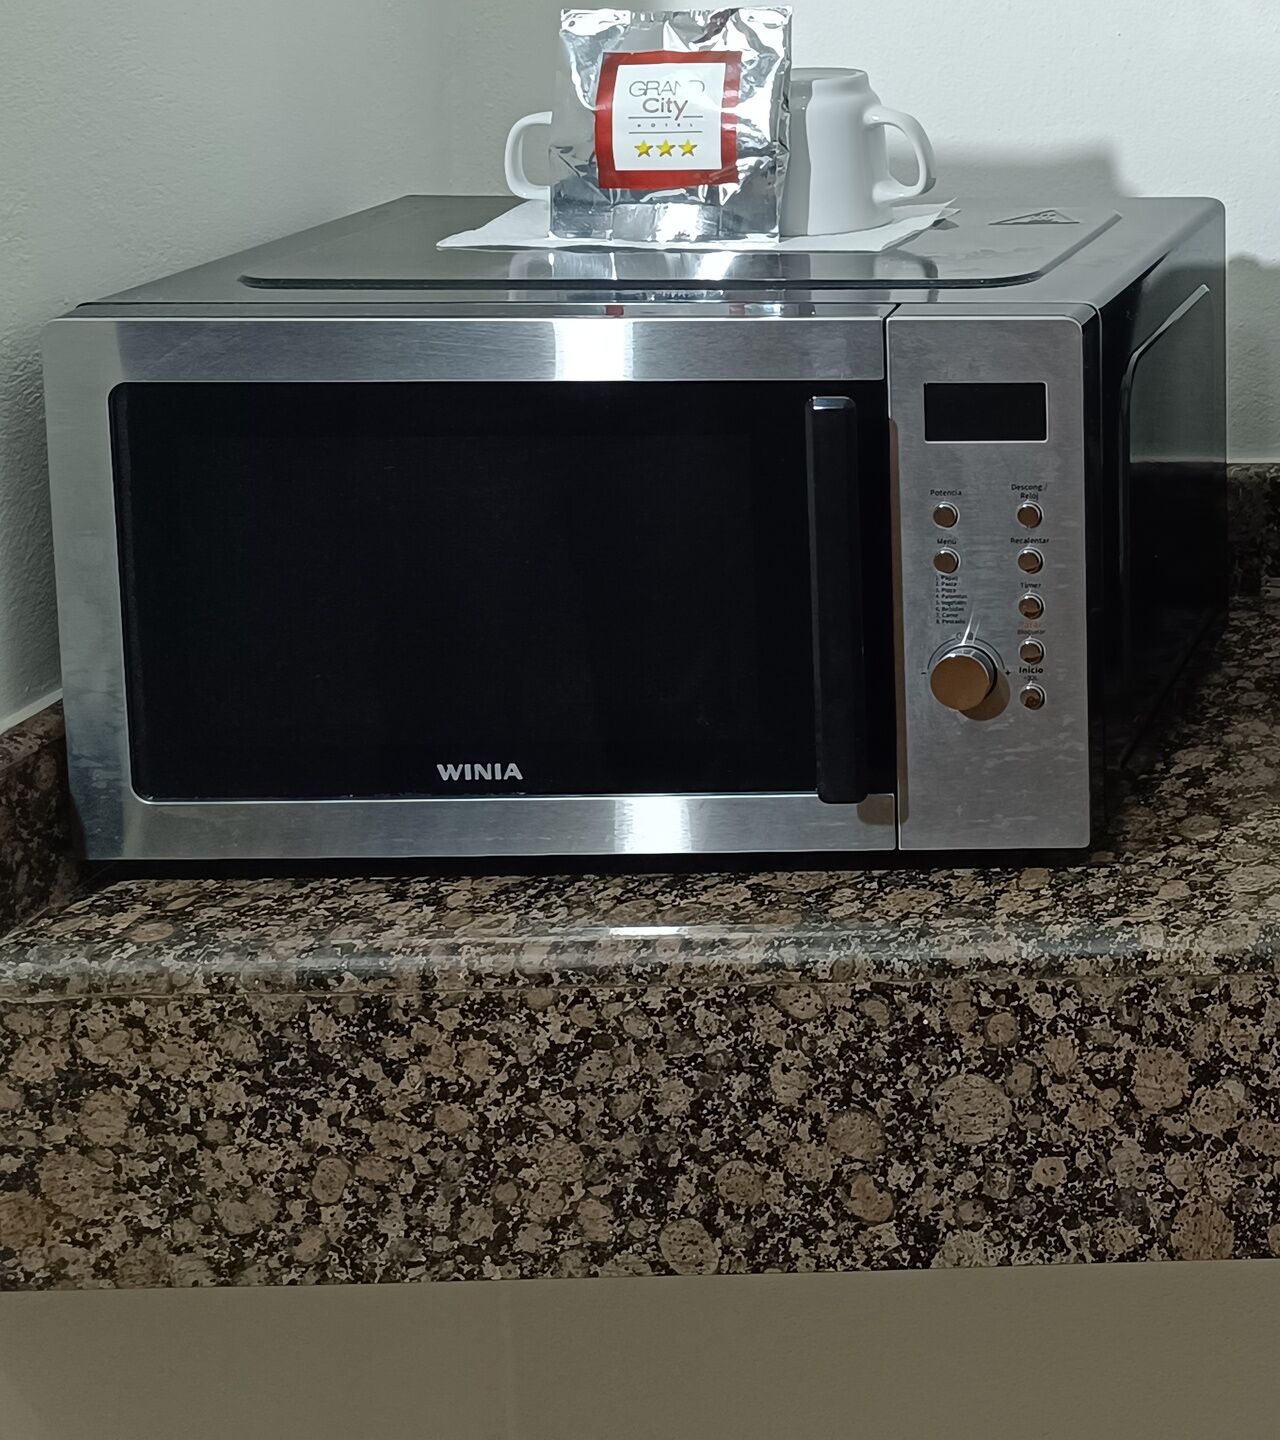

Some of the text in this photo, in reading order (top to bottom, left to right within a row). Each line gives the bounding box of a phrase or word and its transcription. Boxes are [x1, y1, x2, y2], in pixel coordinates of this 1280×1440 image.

[642, 97, 688, 121] City
[930, 489, 962, 497] Potencia
[1020, 492, 1039, 501] Reloj
[1010, 537, 1050, 545] Recalentar
[1019, 666, 1044, 674] Inicio
[436, 763, 524, 781] WINIA
